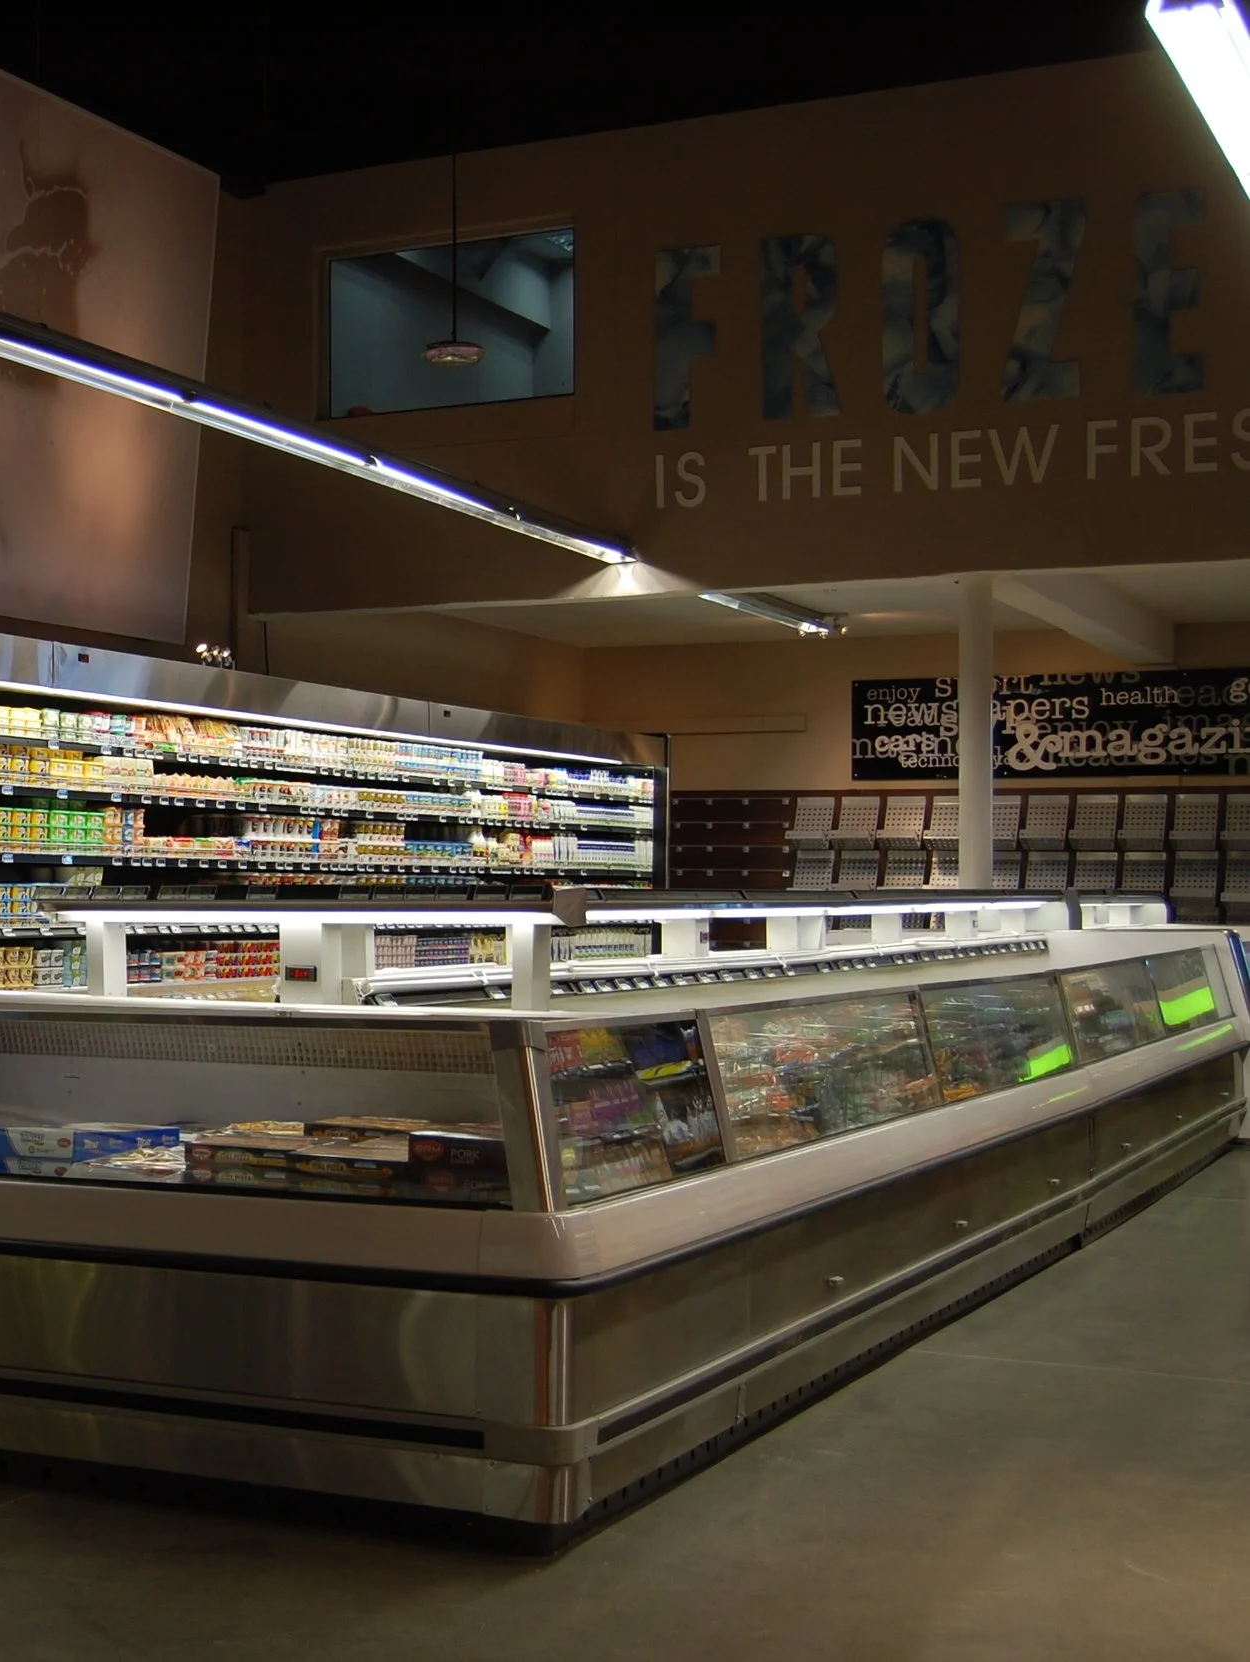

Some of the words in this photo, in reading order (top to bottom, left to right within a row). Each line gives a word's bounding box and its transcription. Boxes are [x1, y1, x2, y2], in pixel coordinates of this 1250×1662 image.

[653, 188, 1207, 431] FROZE
[654, 452, 707, 509] IS
[748, 438, 863, 502] THE
[893, 423, 1060, 494] NEW
[1086, 407, 1250, 481] FRES
[866, 685, 922, 704] enjoy
[1099, 685, 1178, 706] health
[1007, 721, 1060, 771] &
[1057, 718, 1250, 766] magazi
[450, 1147, 481, 1161] PORK
